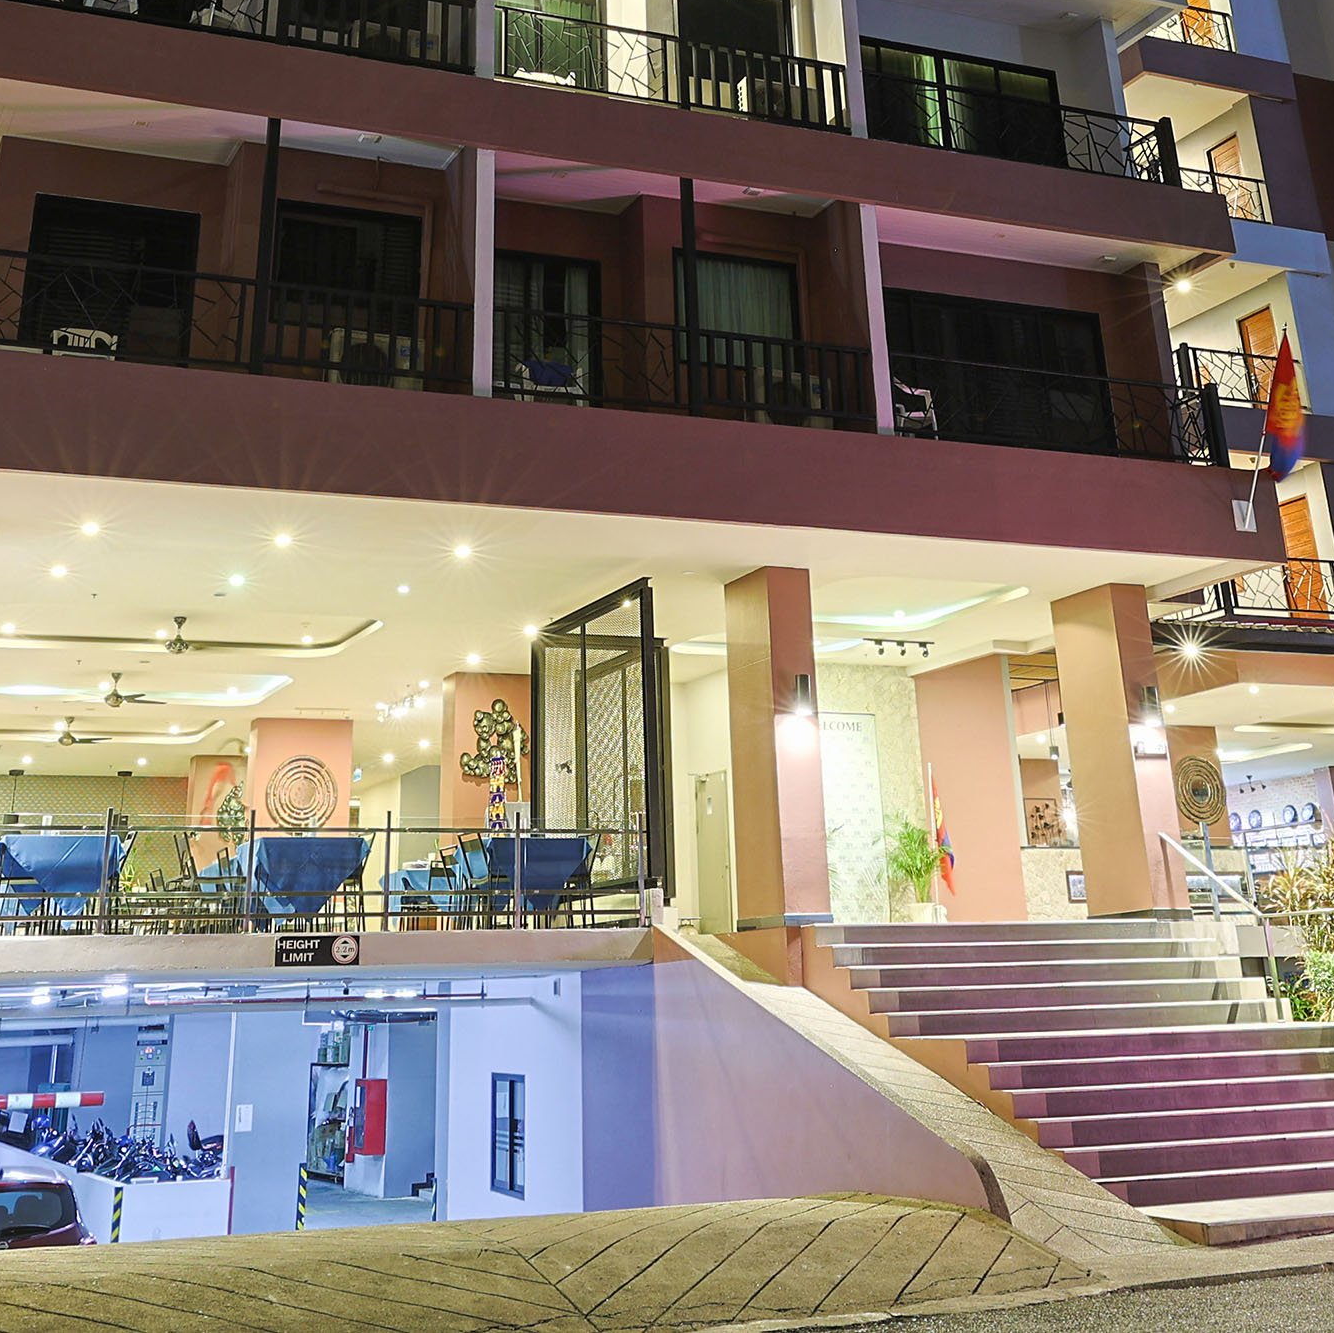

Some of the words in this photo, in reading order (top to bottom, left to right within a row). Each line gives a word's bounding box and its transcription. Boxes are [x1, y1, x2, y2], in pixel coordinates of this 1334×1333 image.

[819, 721, 863, 732] LCOME
[277, 939, 321, 950] HEIGHT
[282, 952, 315, 963] LIMIT
